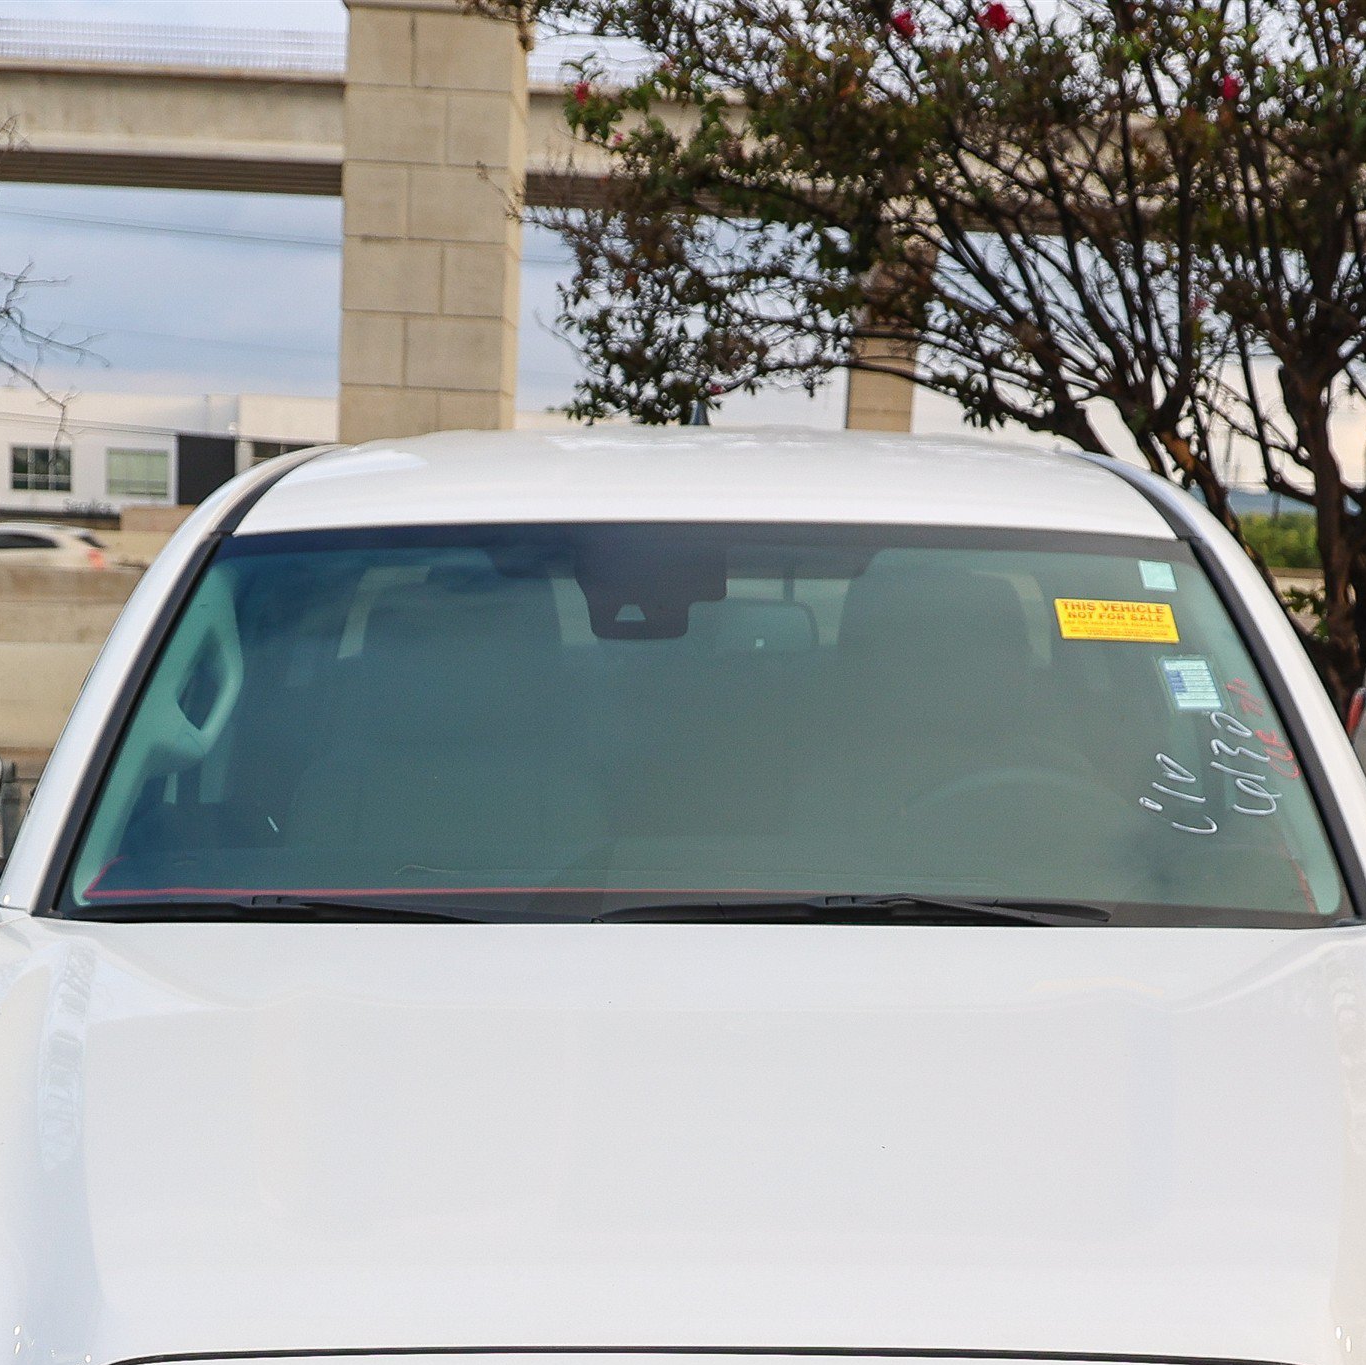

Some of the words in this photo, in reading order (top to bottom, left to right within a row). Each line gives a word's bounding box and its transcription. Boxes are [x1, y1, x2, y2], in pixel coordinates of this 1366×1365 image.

[1061, 600, 1096, 611] THIS
[1100, 602, 1165, 615] VEHICLE
[1068, 611, 1093, 620] NOT
[1099, 612, 1126, 621] FOR
[1130, 612, 1164, 623] SALE
